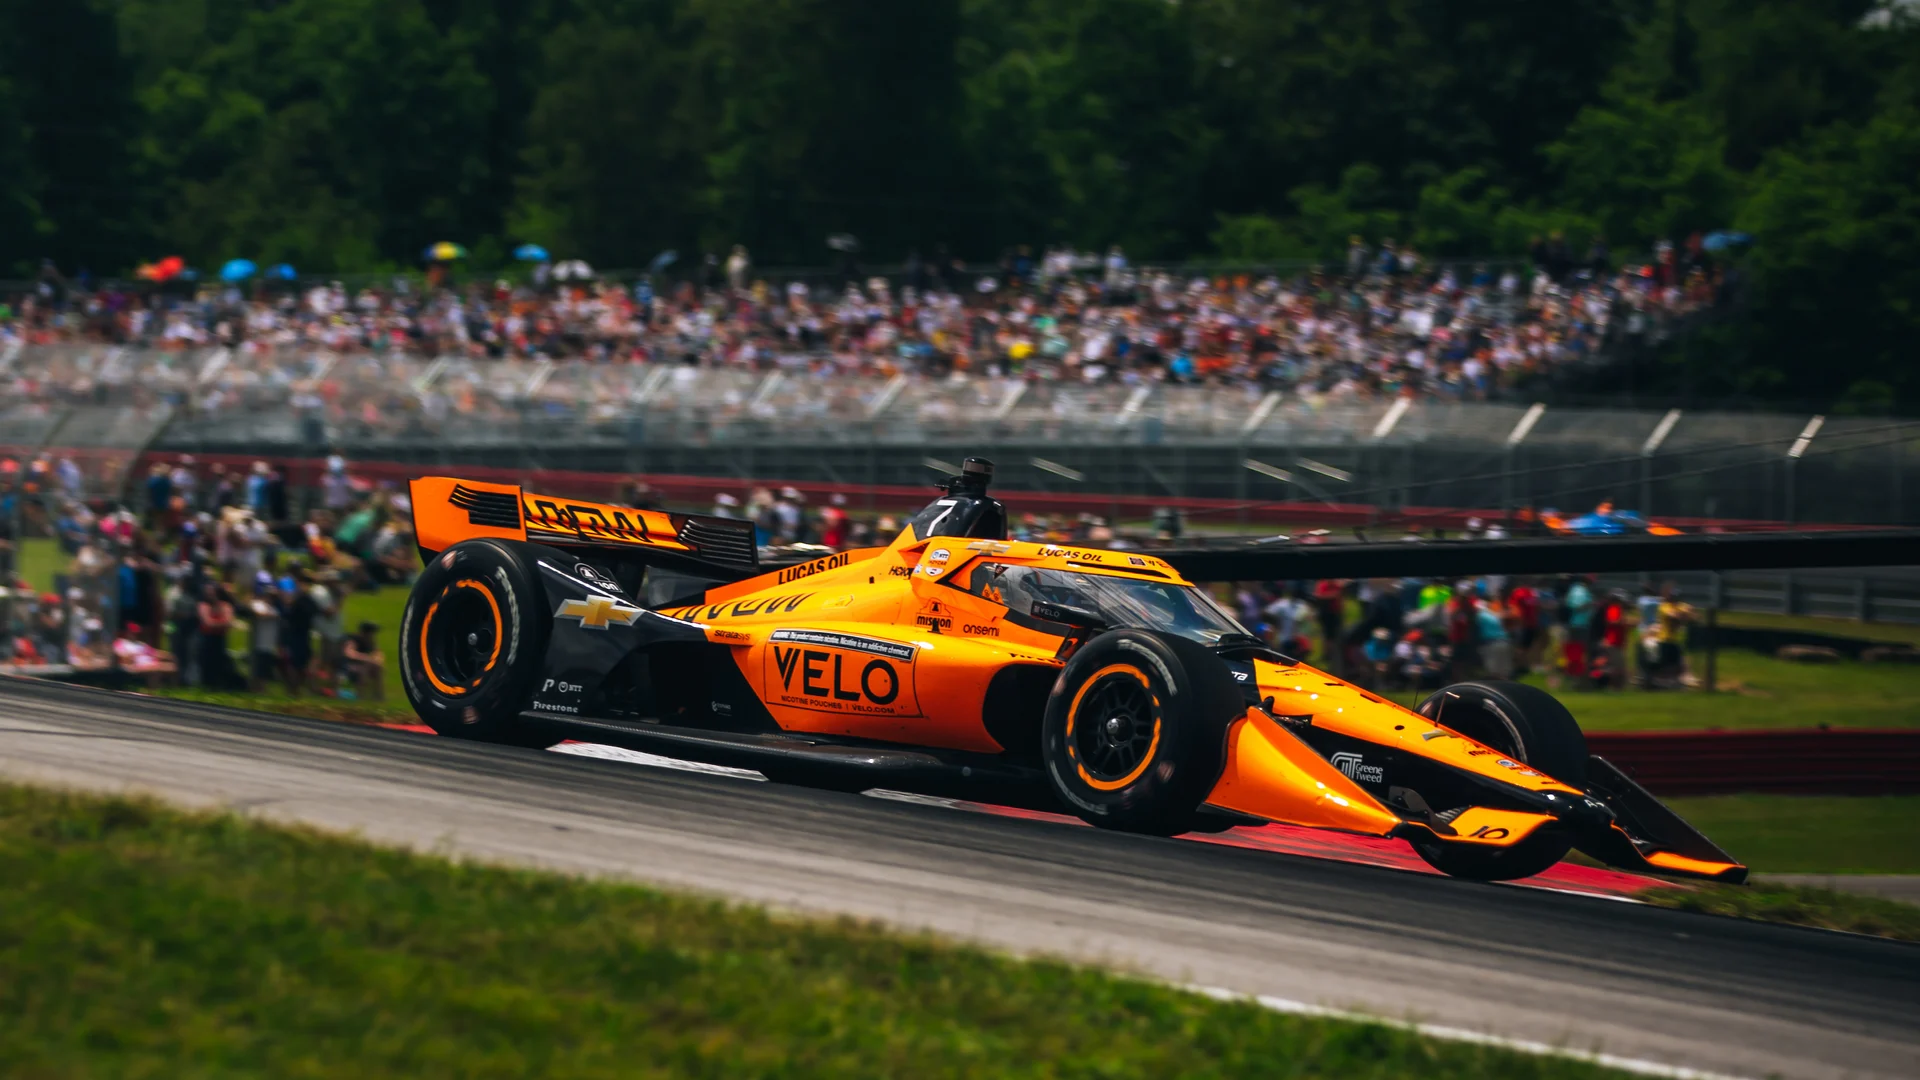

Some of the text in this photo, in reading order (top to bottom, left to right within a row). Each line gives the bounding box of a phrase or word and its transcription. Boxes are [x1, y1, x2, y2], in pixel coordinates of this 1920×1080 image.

[926, 500, 958, 537] 7
[1037, 547, 1103, 562] LUCAS OIL
[778, 560, 825, 585] LUCAS
[1040, 607, 1060, 618] VELO
[773, 646, 899, 705] VELO
[533, 701, 579, 713] Firestone
[781, 695, 895, 713] NICOTINE POUCHES VELO.COM
[1355, 763, 1383, 774] Greene
[1356, 771, 1383, 783] Tweed
